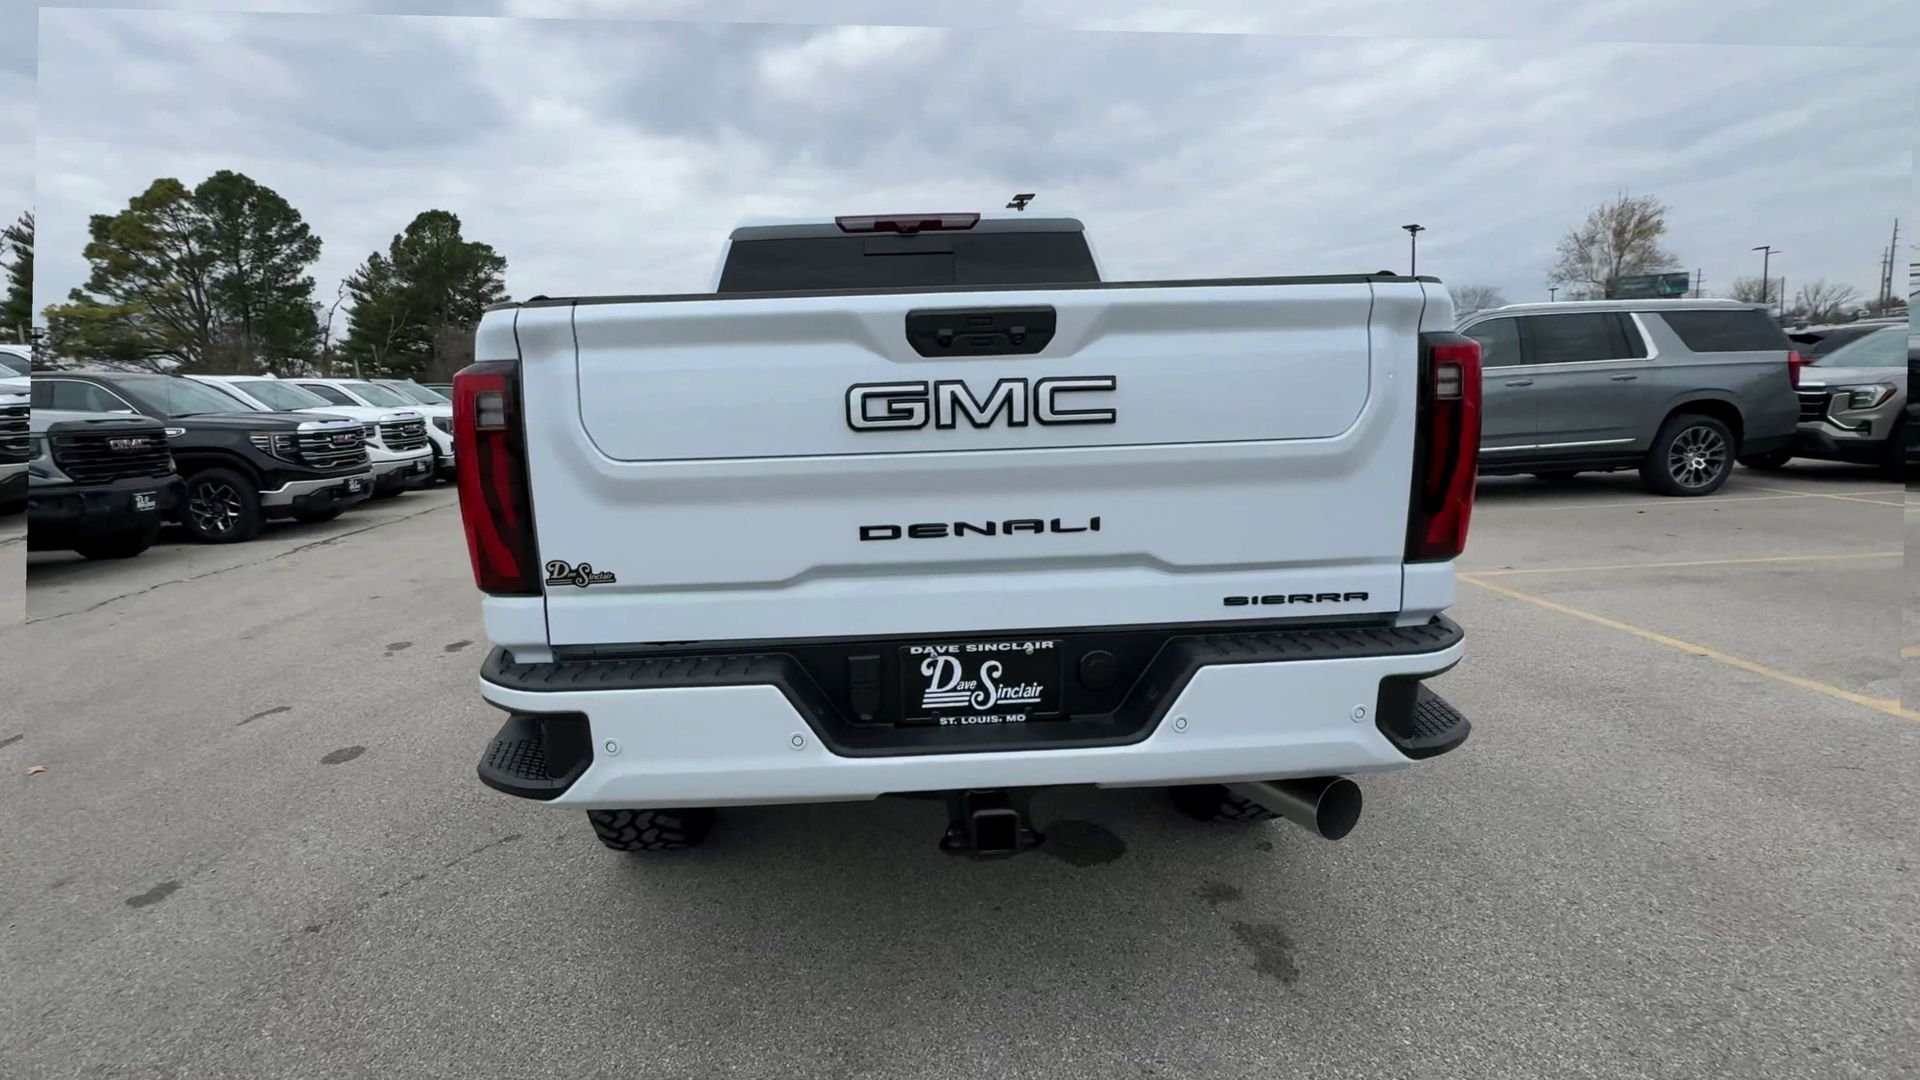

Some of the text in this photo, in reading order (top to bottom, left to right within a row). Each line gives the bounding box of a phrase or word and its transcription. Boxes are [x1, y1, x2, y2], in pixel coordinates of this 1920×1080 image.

[846, 375, 1117, 432] GMC
[859, 516, 1101, 541] DENALI
[1223, 592, 1369, 606] SIERRA
[910, 640, 1055, 655] DAVE SINCLAIR
[920, 655, 1044, 711] Dave Sinclair
[939, 716, 958, 726] ST.
[1006, 713, 1027, 723] MO
